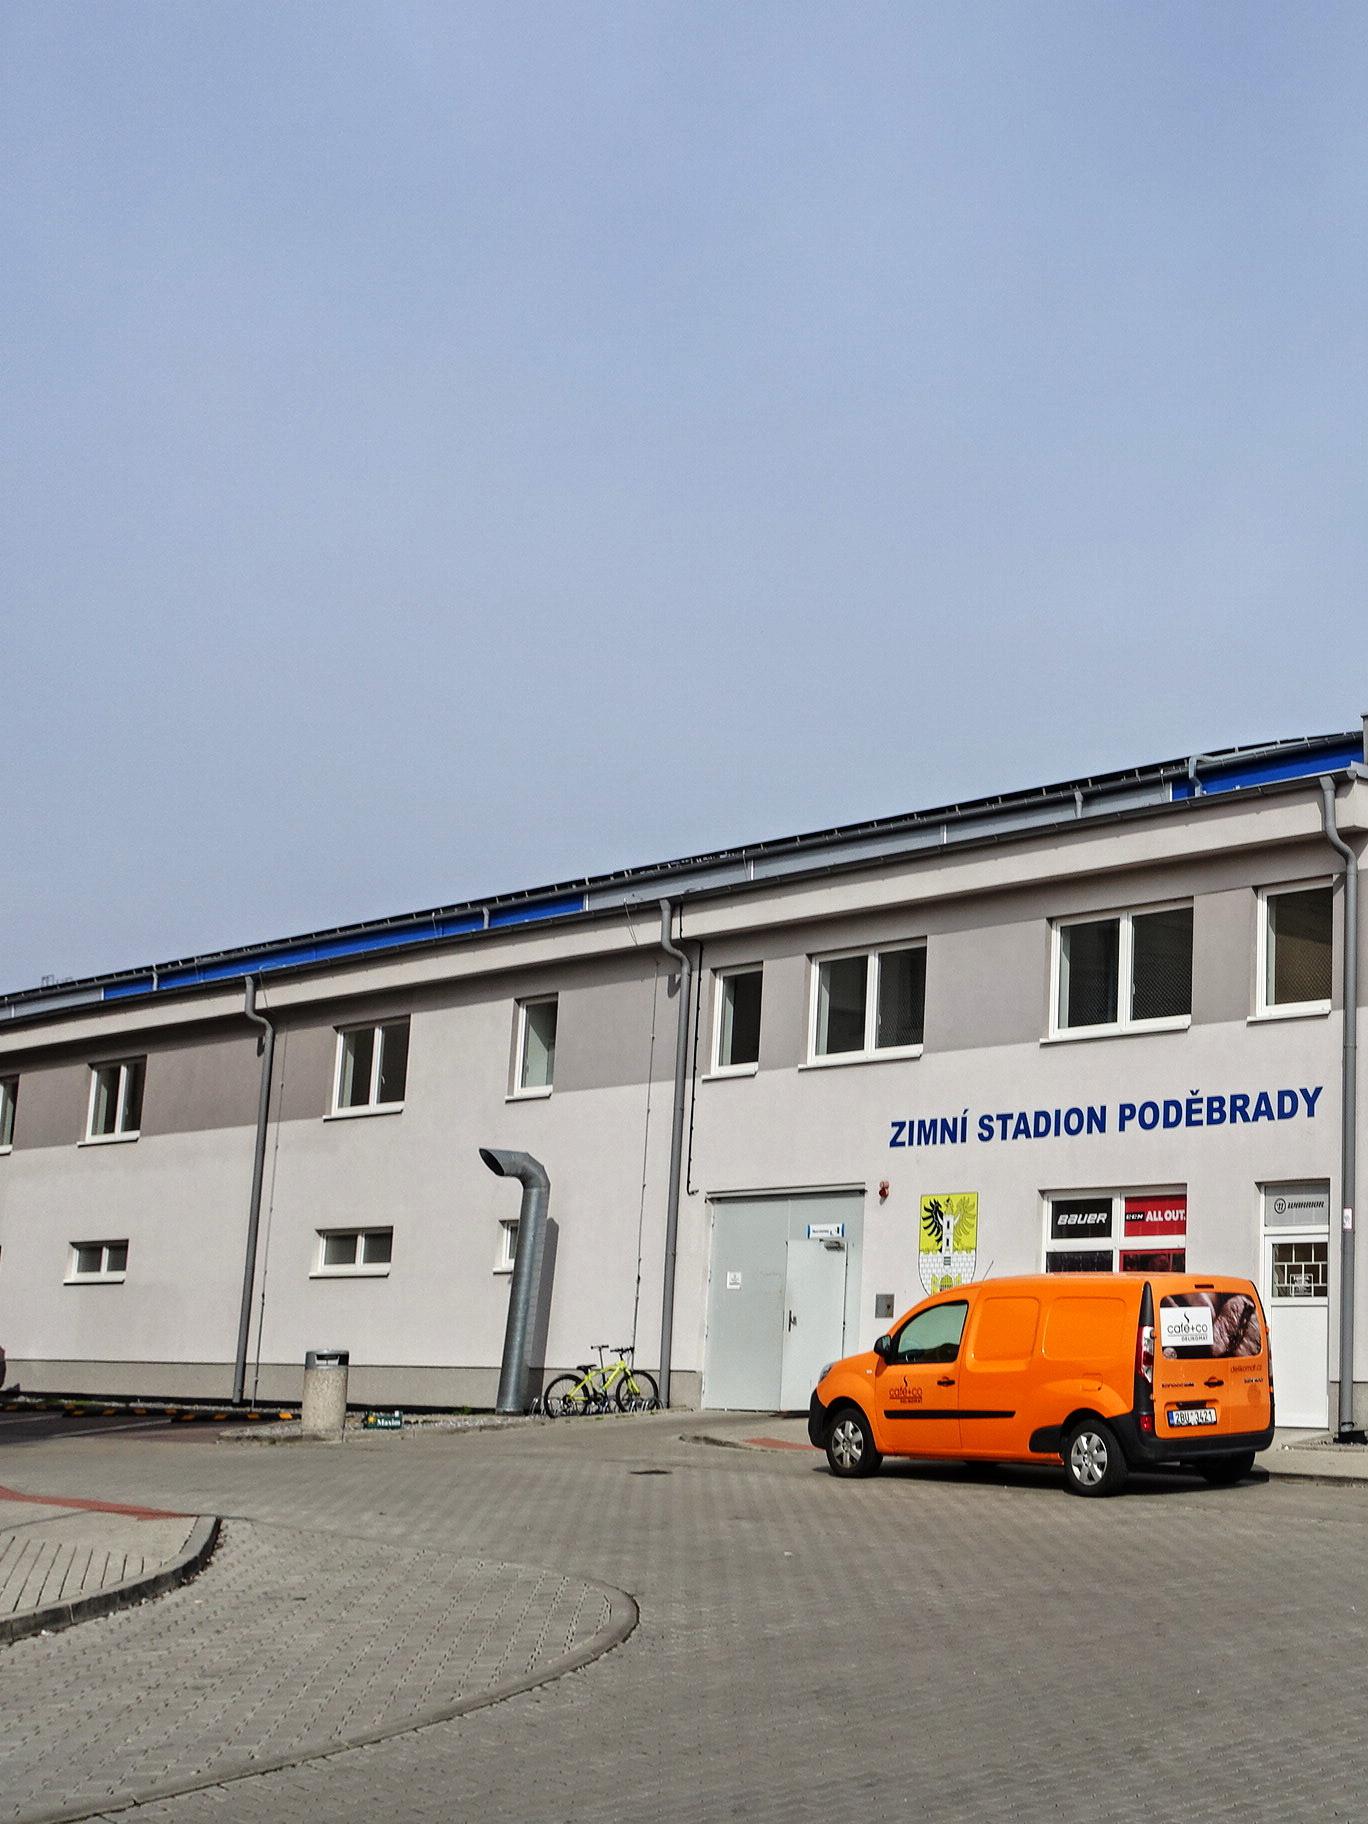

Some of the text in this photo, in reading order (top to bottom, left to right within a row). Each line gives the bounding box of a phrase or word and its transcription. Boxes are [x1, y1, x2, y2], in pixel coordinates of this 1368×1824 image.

[888, 1086, 1323, 1148] ZIMNÍ STADION PODĚBRADY
[1057, 1212, 1108, 1225] BAUER
[1145, 1210, 1163, 1222] ALL
